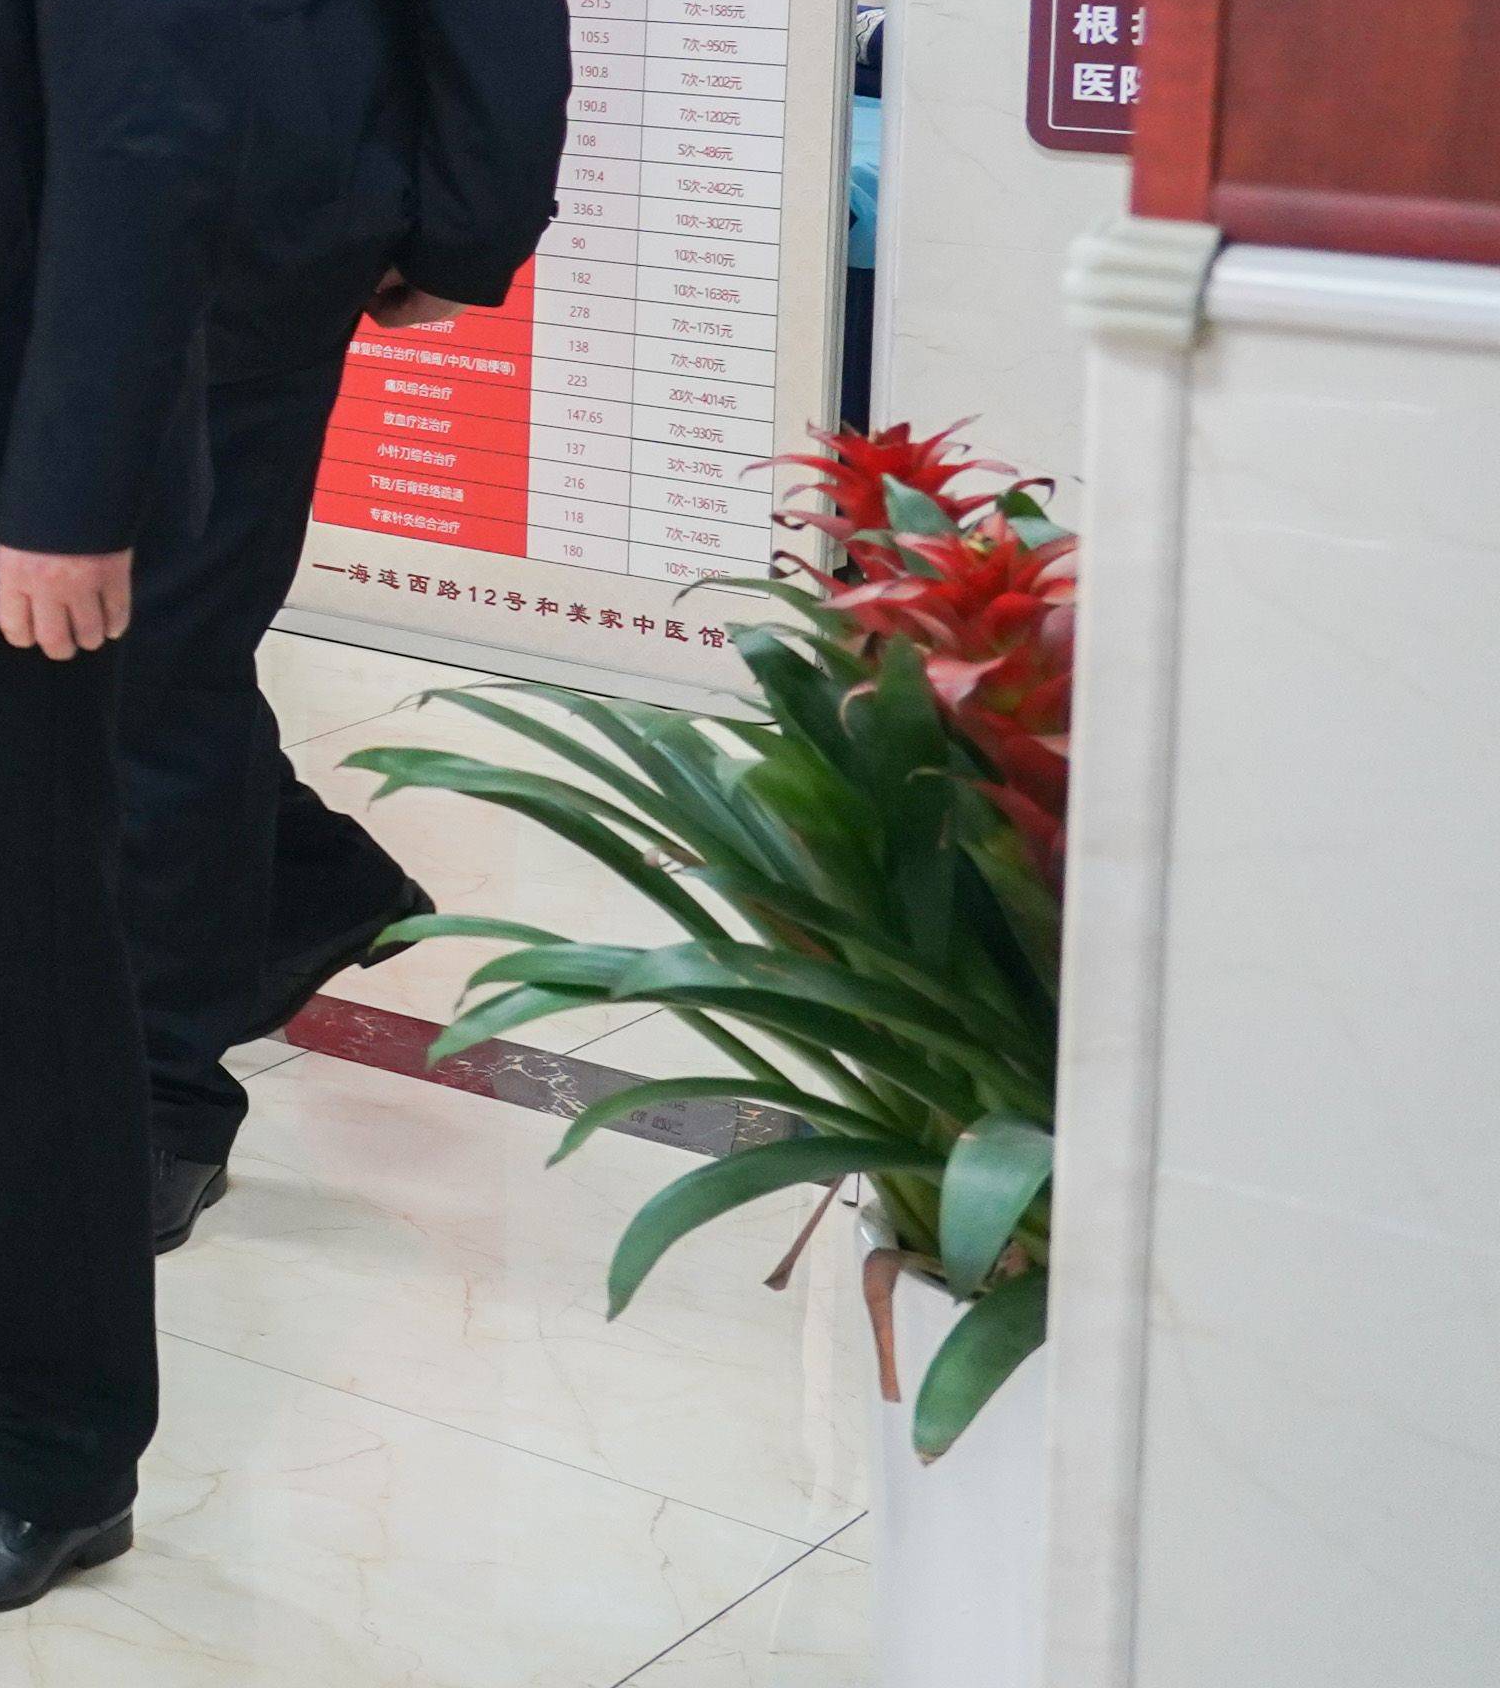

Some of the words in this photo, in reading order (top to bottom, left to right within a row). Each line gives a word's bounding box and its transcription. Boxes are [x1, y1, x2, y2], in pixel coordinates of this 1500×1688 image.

[578, 65, 608, 78] 190.8
[577, 100, 607, 112] 190.8
[576, 135, 596, 147] 108
[574, 169, 604, 181] 179.4
[573, 204, 603, 216] 336.3
[571, 238, 585, 250] 90
[571, 272, 591, 284] 182
[569, 307, 590, 319] 278
[568, 342, 589, 352] 138
[566, 375, 587, 387] 223
[566, 409, 603, 423] 147.65
[565, 443, 586, 455] 137
[563, 477, 585, 489] 216
[564, 511, 584, 523] 118
[562, 545, 583, 557] 180
